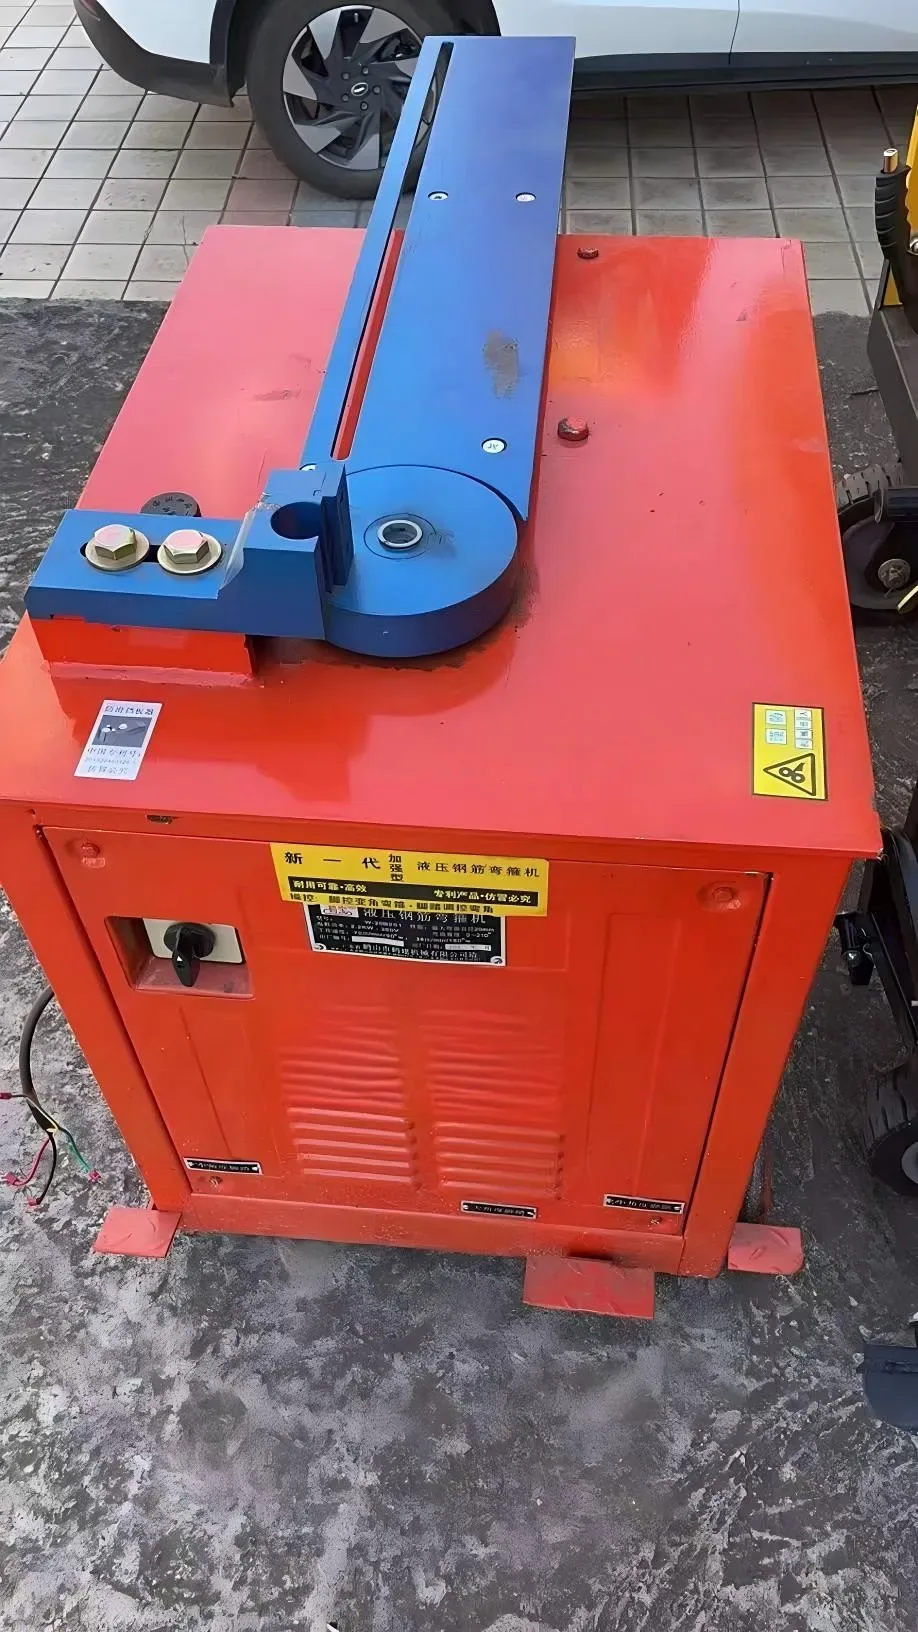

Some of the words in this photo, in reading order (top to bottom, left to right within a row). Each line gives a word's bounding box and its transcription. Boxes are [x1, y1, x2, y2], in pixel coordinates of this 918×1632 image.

[388, 853, 404, 882] 加强型
[416, 861, 540, 878] 液压钢筋弯箍机
